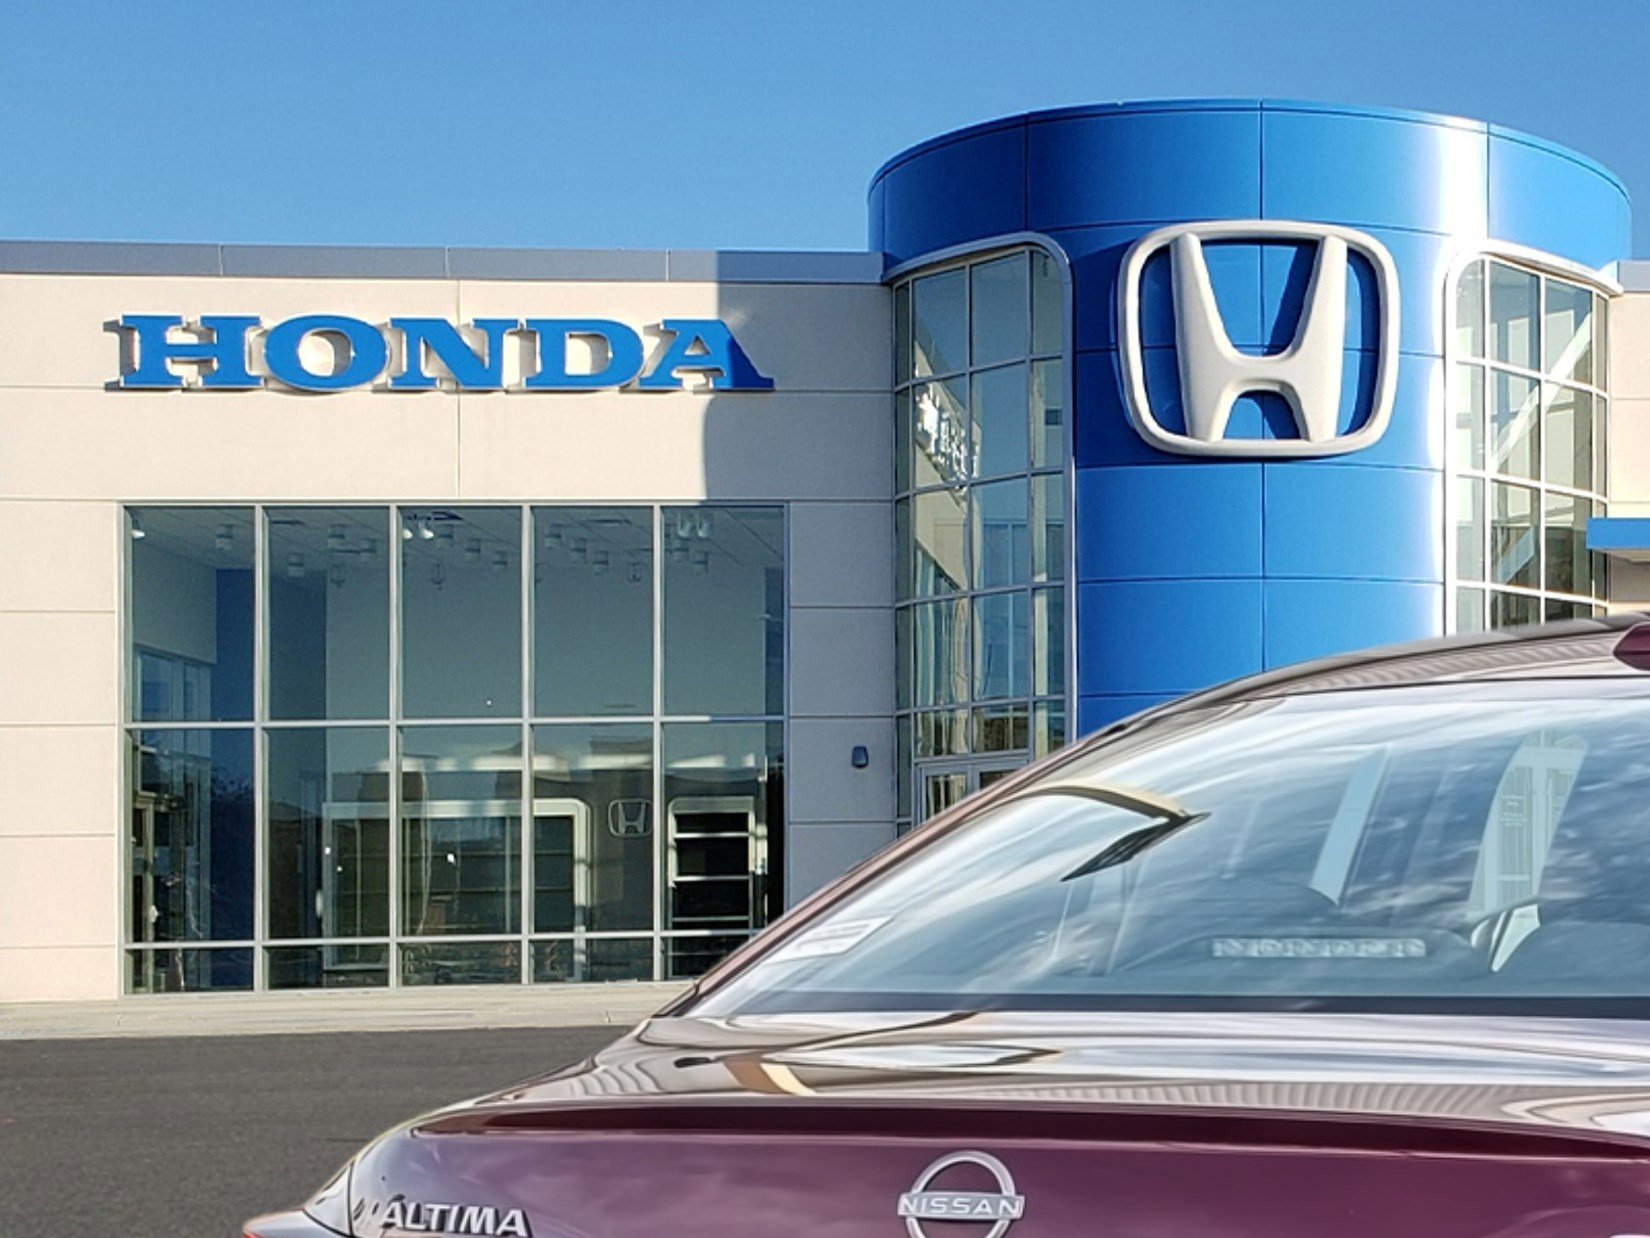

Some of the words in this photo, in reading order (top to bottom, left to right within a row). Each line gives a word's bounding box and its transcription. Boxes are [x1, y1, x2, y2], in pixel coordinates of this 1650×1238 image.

[118, 313, 775, 391] HONDA
[381, 1200, 532, 1238] ALTIMA
[900, 1196, 1021, 1216] NISSAN
